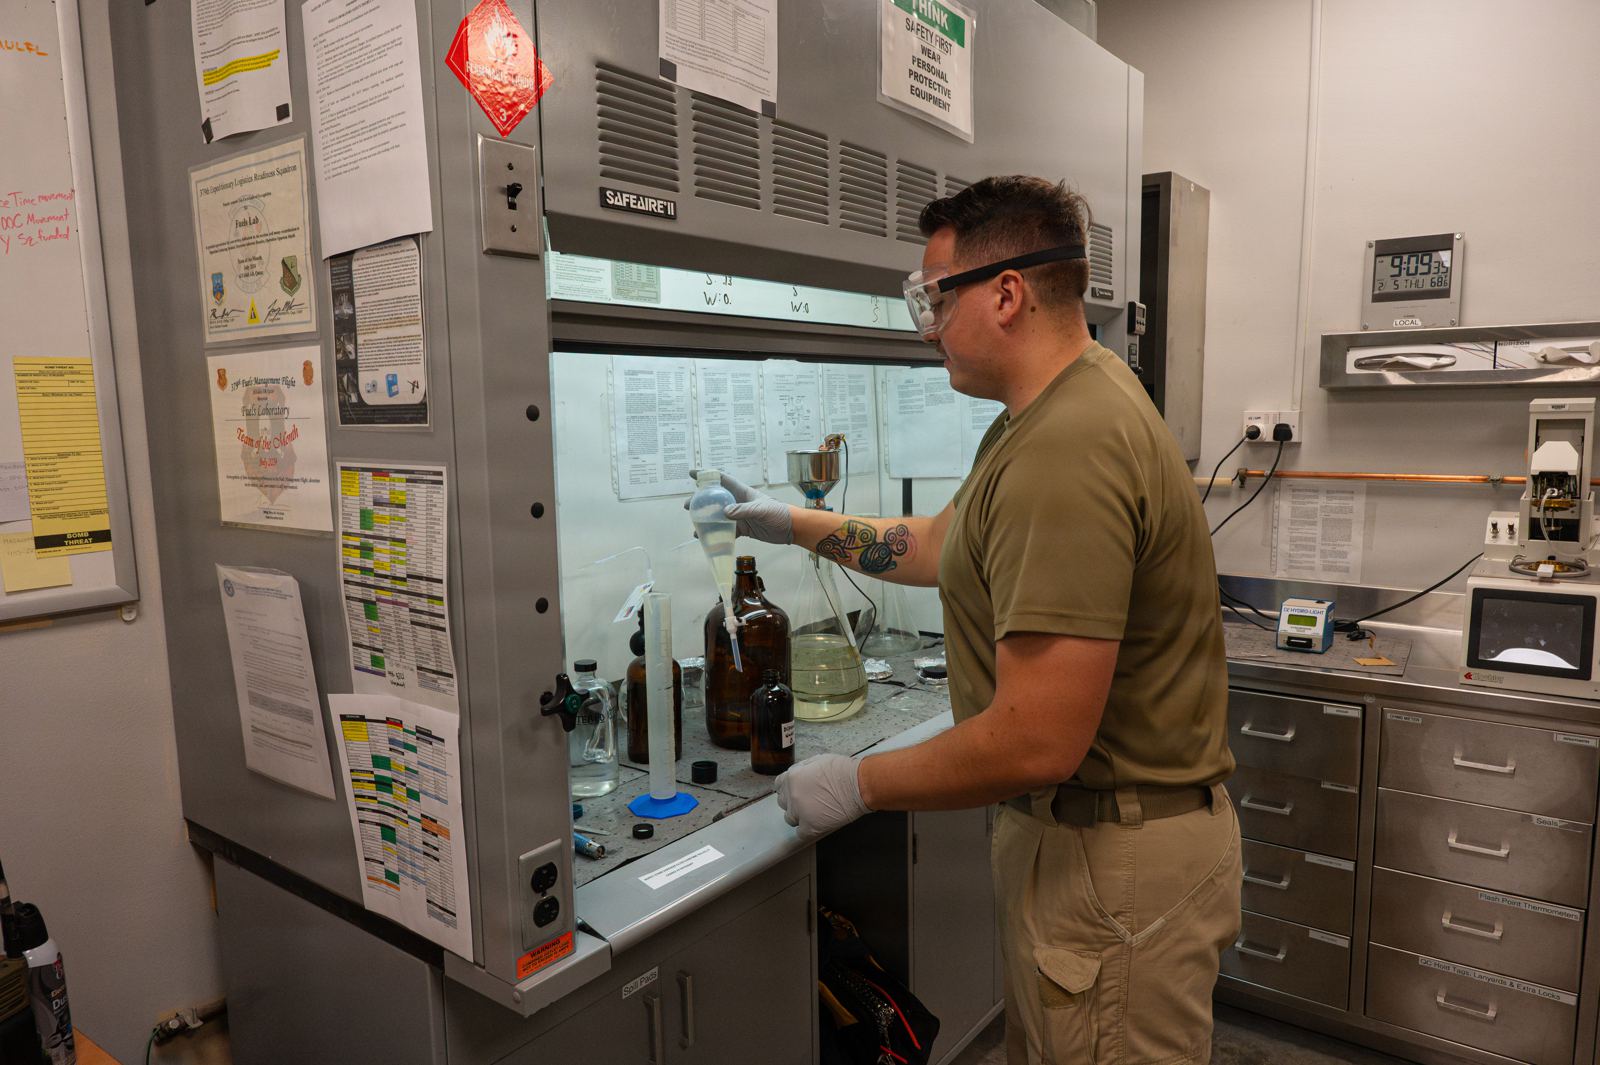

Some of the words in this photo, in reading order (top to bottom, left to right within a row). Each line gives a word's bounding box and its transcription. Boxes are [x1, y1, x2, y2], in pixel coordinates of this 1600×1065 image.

[905, 18, 934, 43] SAFETY
[935, 32, 952, 55] FIRST
[920, 44, 941, 64] WEAR
[911, 55, 949, 83] PERSONAL
[908, 68, 951, 99] PROTECTIVE
[909, 84, 951, 112] EQUIPMENT
[500, 108, 507, 122] 3
[1390, 253, 1432, 277] 9:09
[1404, 278, 1425, 289] THU
[1394, 319, 1419, 327] LOCAL
[254, 377, 281, 387] Management
[241, 404, 257, 417] Fuels
[257, 402, 290, 420] Laboratory
[64, 537, 93, 546] THREAT
[66, 531, 89, 539] BOMB
[1536, 817, 1559, 827] Seals
[1480, 893, 1500, 902] Flash
[1501, 897, 1521, 907] Point
[1523, 903, 1579, 920] Thermometers
[624, 980, 639, 996] Spill
[640, 971, 657, 984] Pads
[1420, 958, 1432, 966] QC
[1433, 962, 1450, 971] Hold
[1473, 972, 1507, 986] Lanyards
[1516, 984, 1537, 994] Extra
[1537, 988, 1561, 1001] Locks
